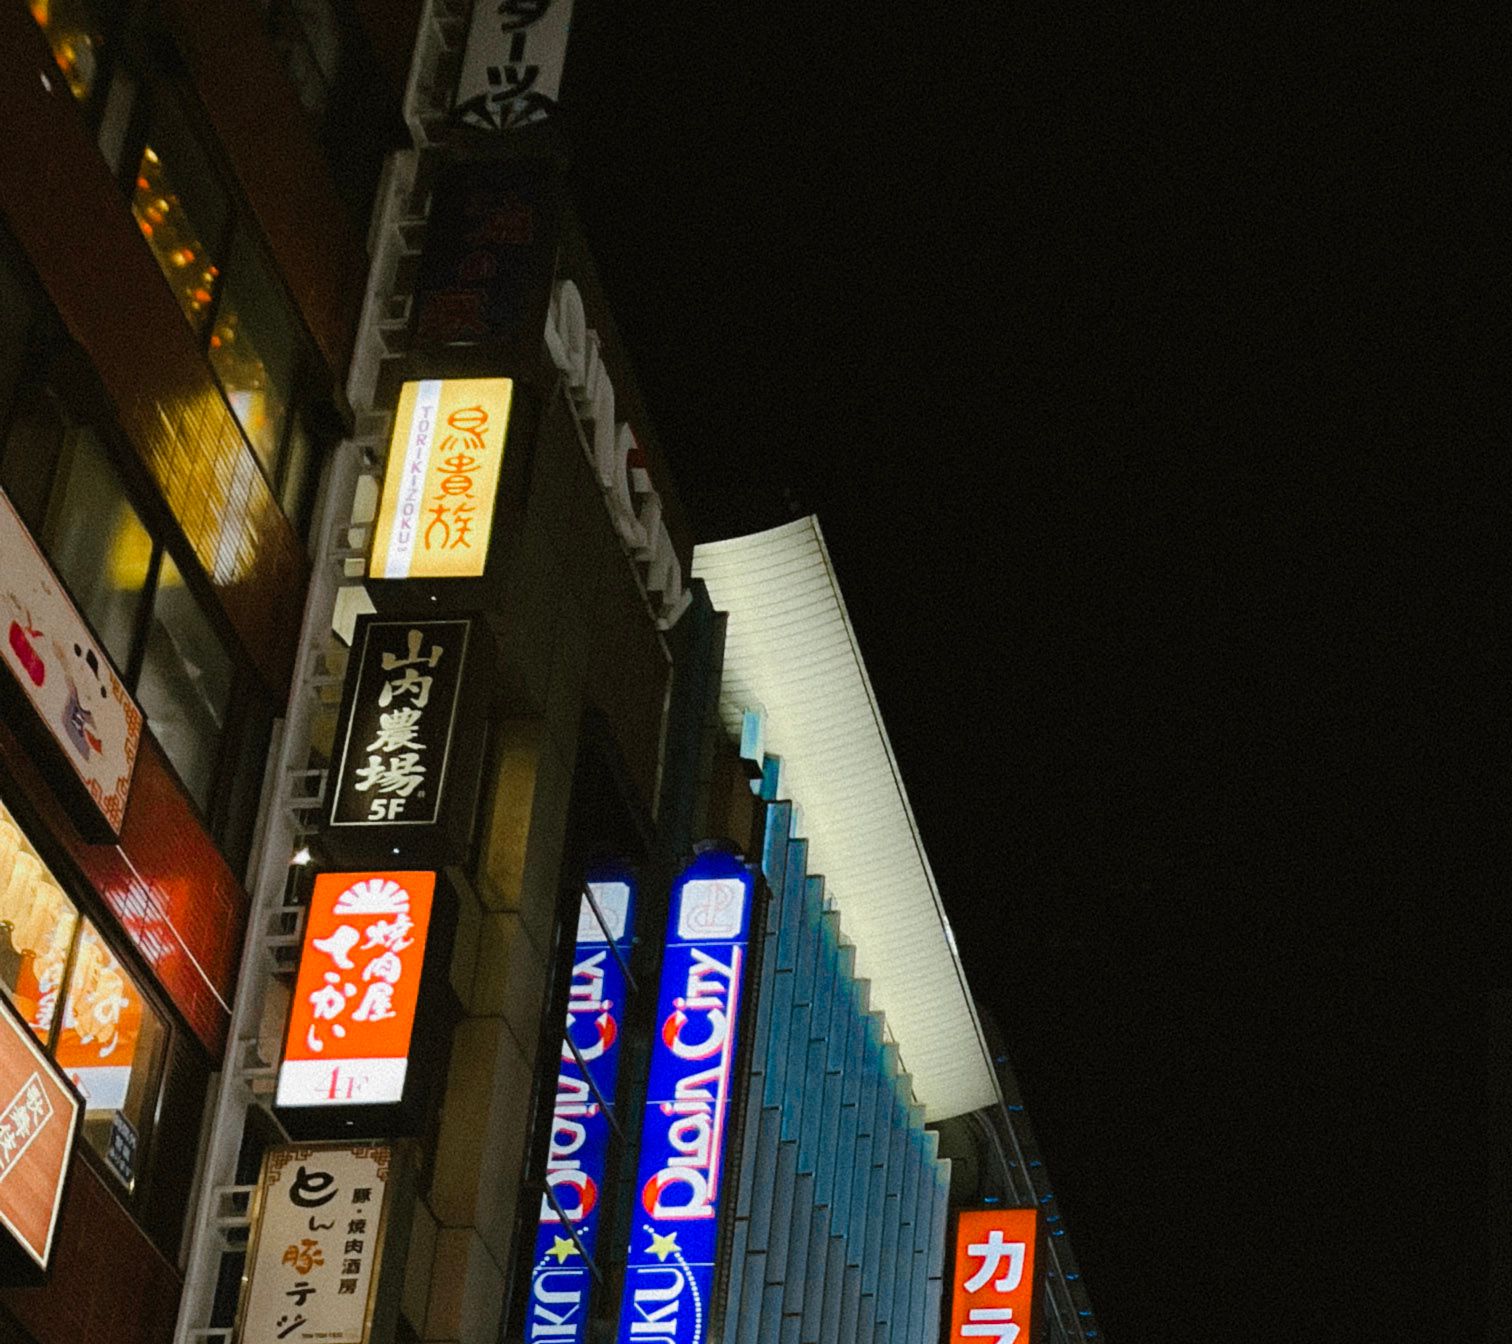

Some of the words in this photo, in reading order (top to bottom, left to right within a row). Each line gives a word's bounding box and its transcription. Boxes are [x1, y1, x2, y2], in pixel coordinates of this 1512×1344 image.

[396, 405, 434, 546] TORIKIZOKU
[425, 406, 489, 550] 鳥貴族
[355, 631, 443, 798] 山内農場
[368, 800, 406, 820] 5F
[352, 917, 414, 1023] 焼肉屋
[314, 1067, 371, 1098] 4F
[337, 1187, 372, 1295] 豚・焼肉酒房
